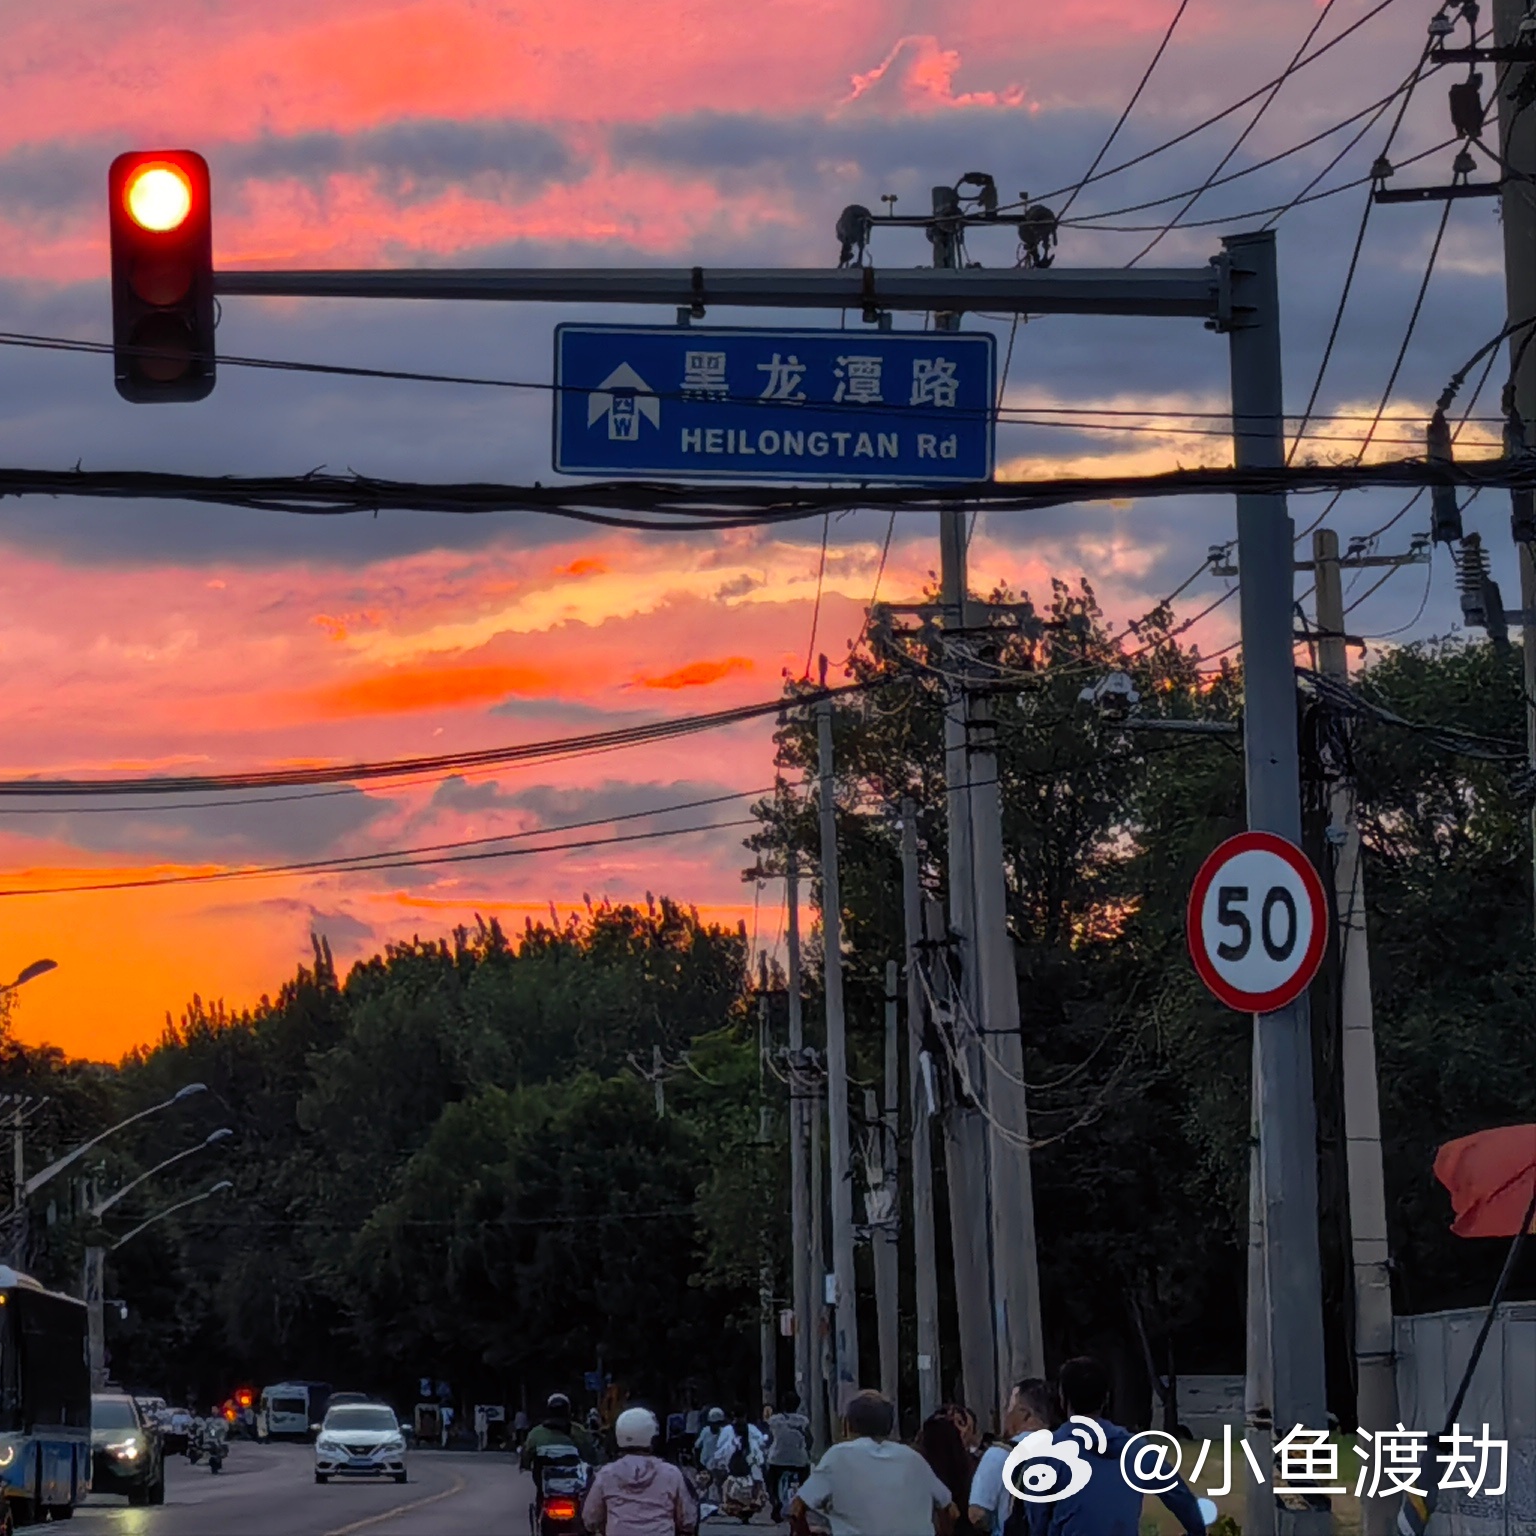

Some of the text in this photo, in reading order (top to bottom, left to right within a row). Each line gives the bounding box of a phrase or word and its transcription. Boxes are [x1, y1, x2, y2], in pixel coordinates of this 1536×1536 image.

[679, 350, 960, 407] 黑龙潭路
[614, 417, 632, 437] W
[681, 427, 957, 459] HEILONGTAN Rd
[1216, 885, 1297, 962] 50
